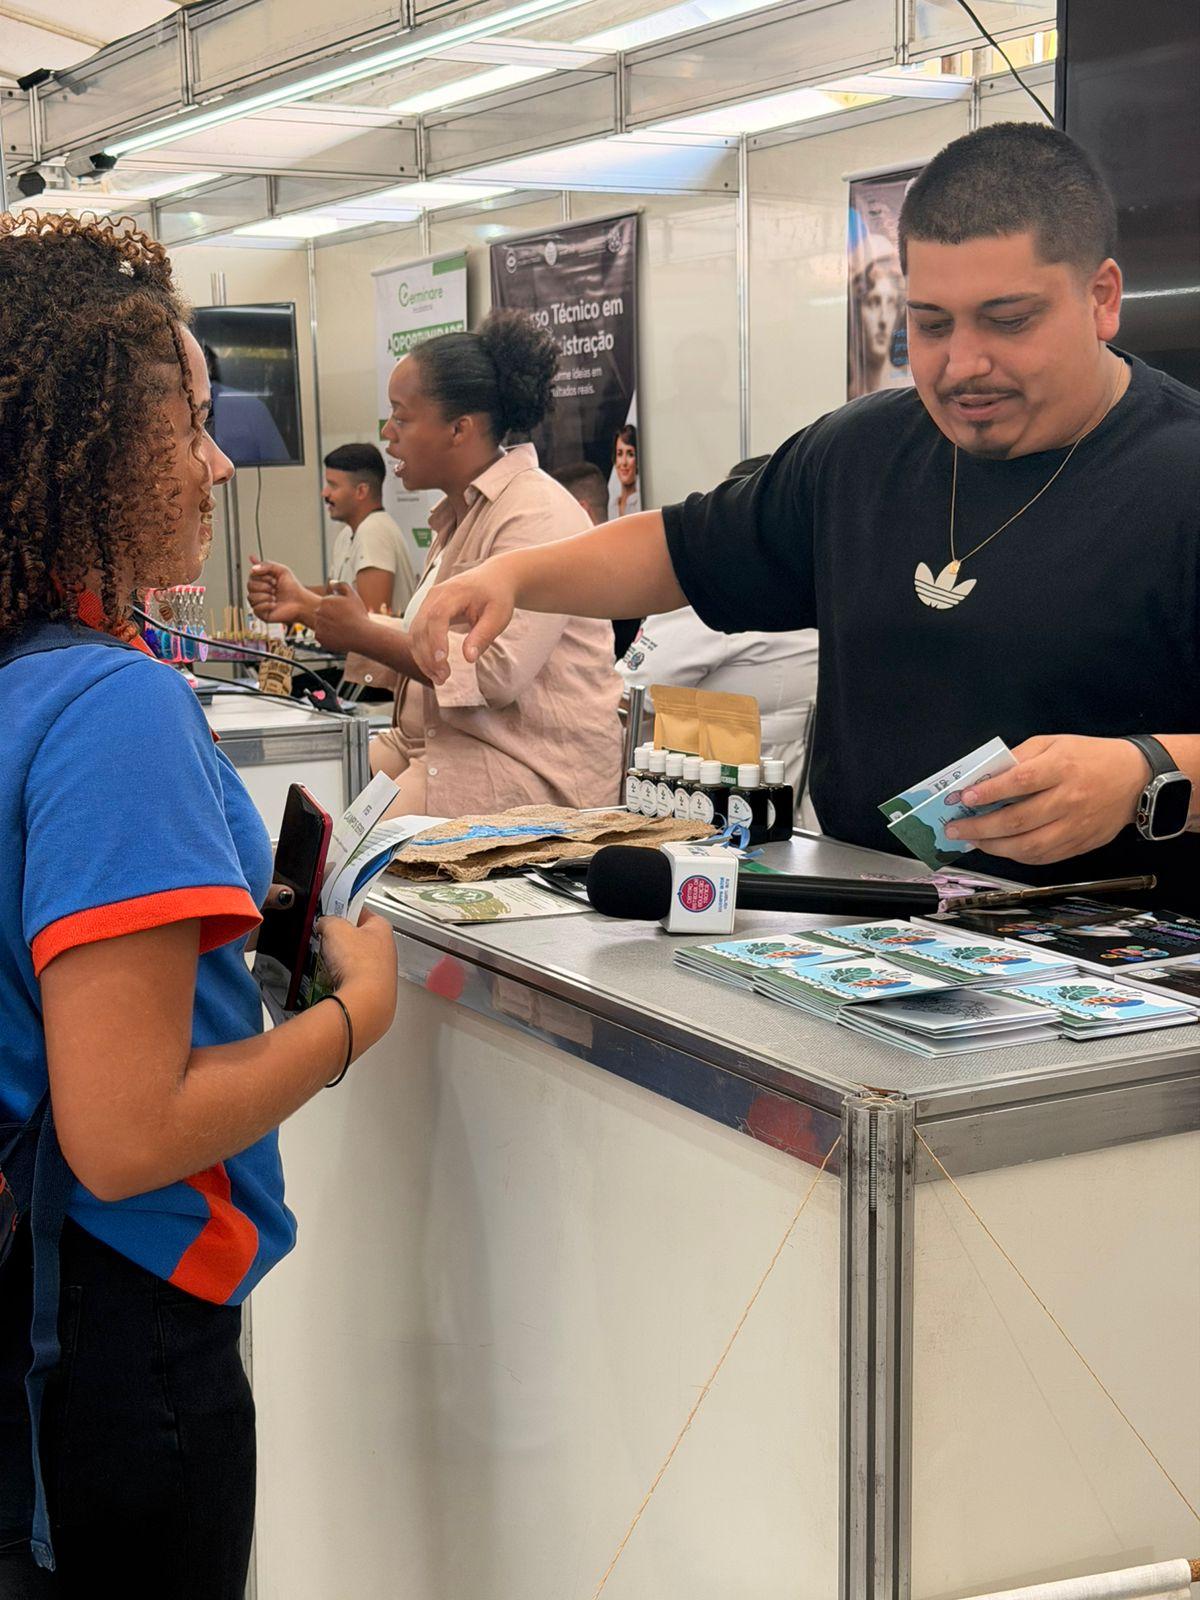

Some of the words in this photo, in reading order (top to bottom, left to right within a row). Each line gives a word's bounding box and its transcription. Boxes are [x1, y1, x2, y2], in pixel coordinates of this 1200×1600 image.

[550, 299, 600, 325] Técnico
[602, 297, 624, 317] em
[561, 330, 614, 359] istração
